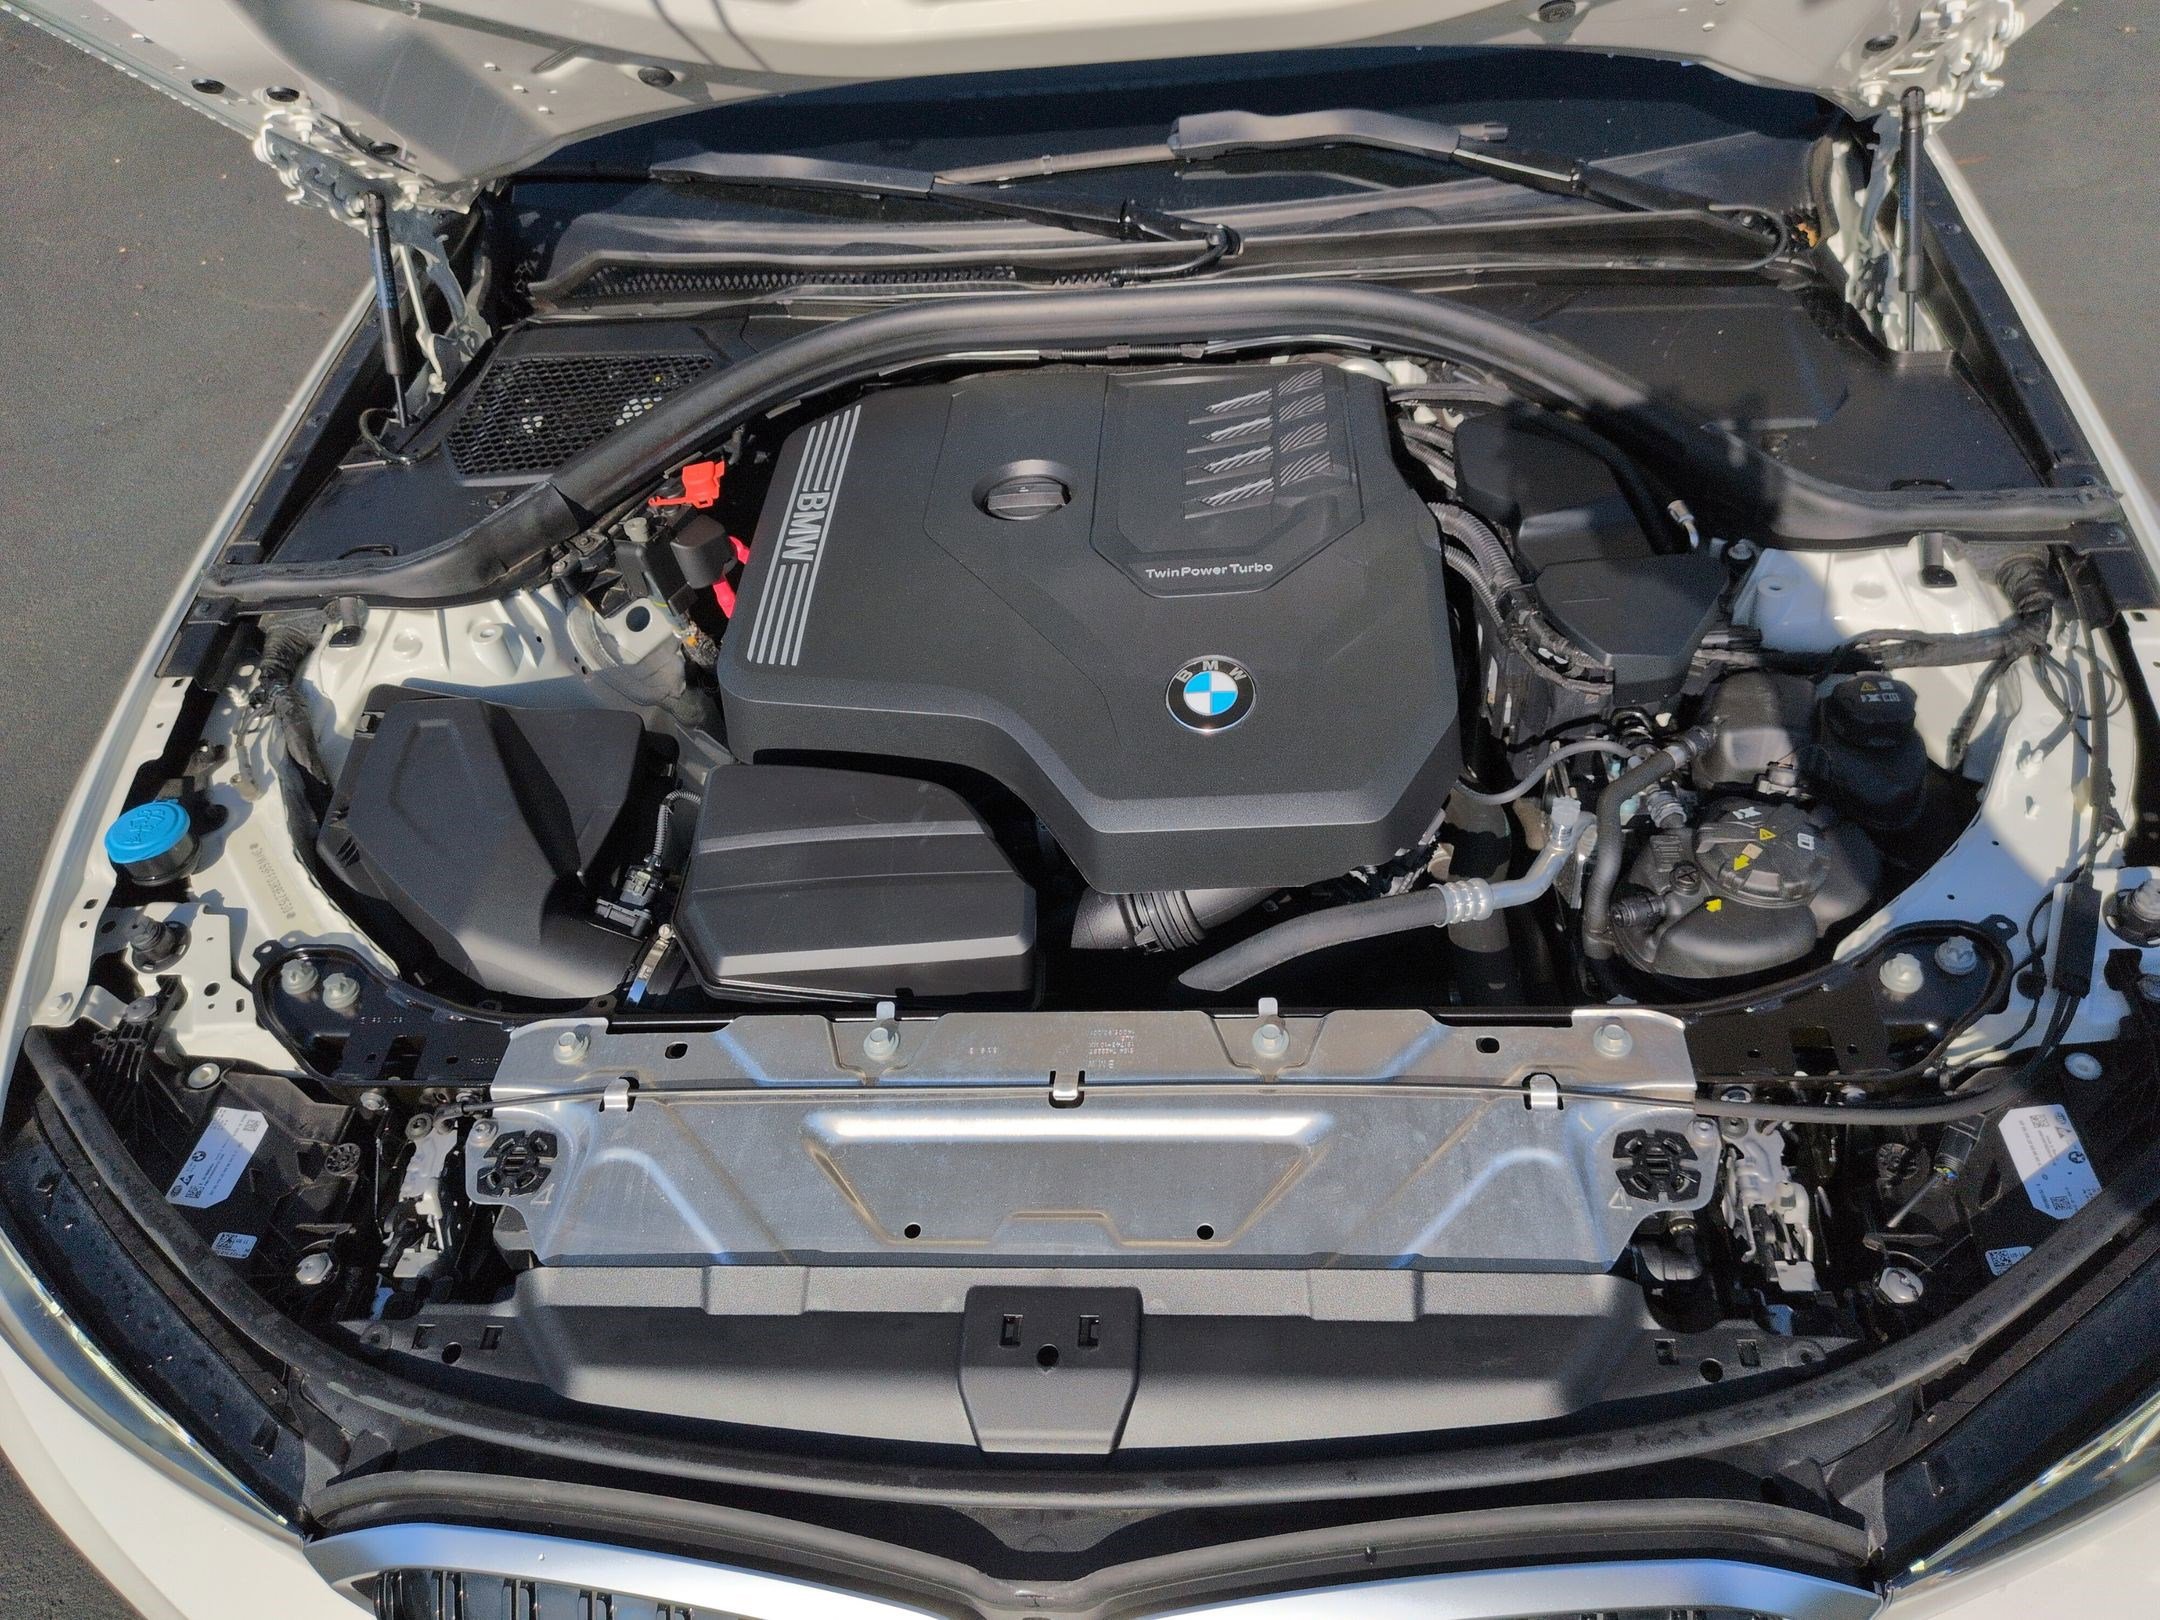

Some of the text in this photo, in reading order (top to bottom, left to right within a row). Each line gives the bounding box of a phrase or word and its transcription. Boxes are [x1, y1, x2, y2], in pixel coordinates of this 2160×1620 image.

[781, 491, 831, 561] BMW
[1229, 562, 1274, 574] Turbo
[1175, 659, 1247, 683] BMW
